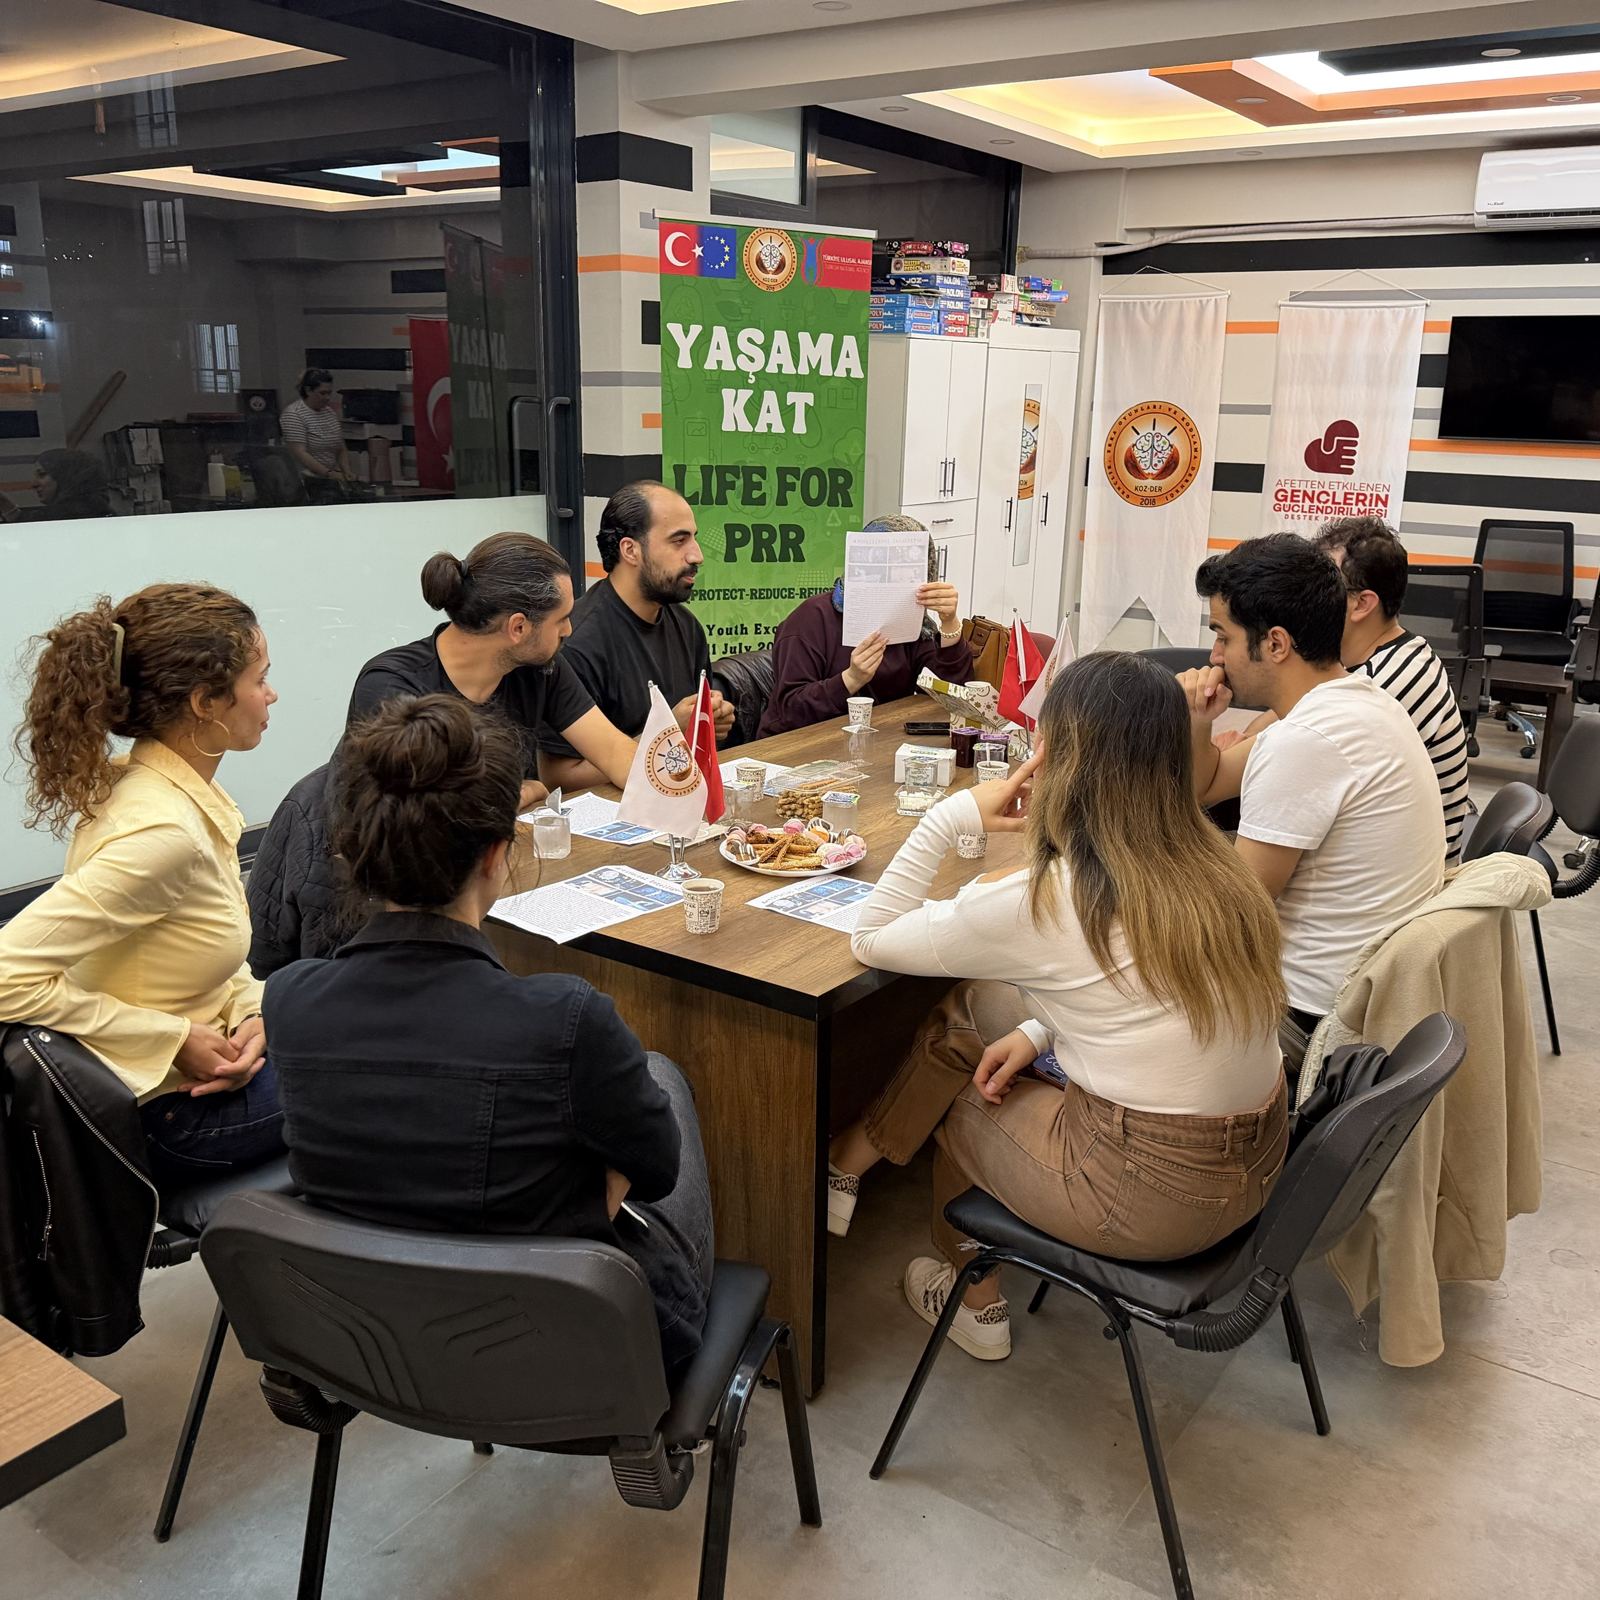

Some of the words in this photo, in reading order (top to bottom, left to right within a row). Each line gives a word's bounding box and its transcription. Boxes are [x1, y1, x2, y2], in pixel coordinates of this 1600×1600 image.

[666, 322, 865, 384] YAŞAMA
[721, 388, 815, 434] KAT
[672, 463, 767, 506] LIFE
[775, 466, 853, 508] FOR
[1275, 478, 1325, 489] AFETTEN
[1139, 497, 1157, 506] 2018
[1284, 513, 1319, 521] DESTEK
[723, 523, 806, 563] PRR
[706, 623, 748, 637] Youth
[754, 623, 778, 635] Exc
